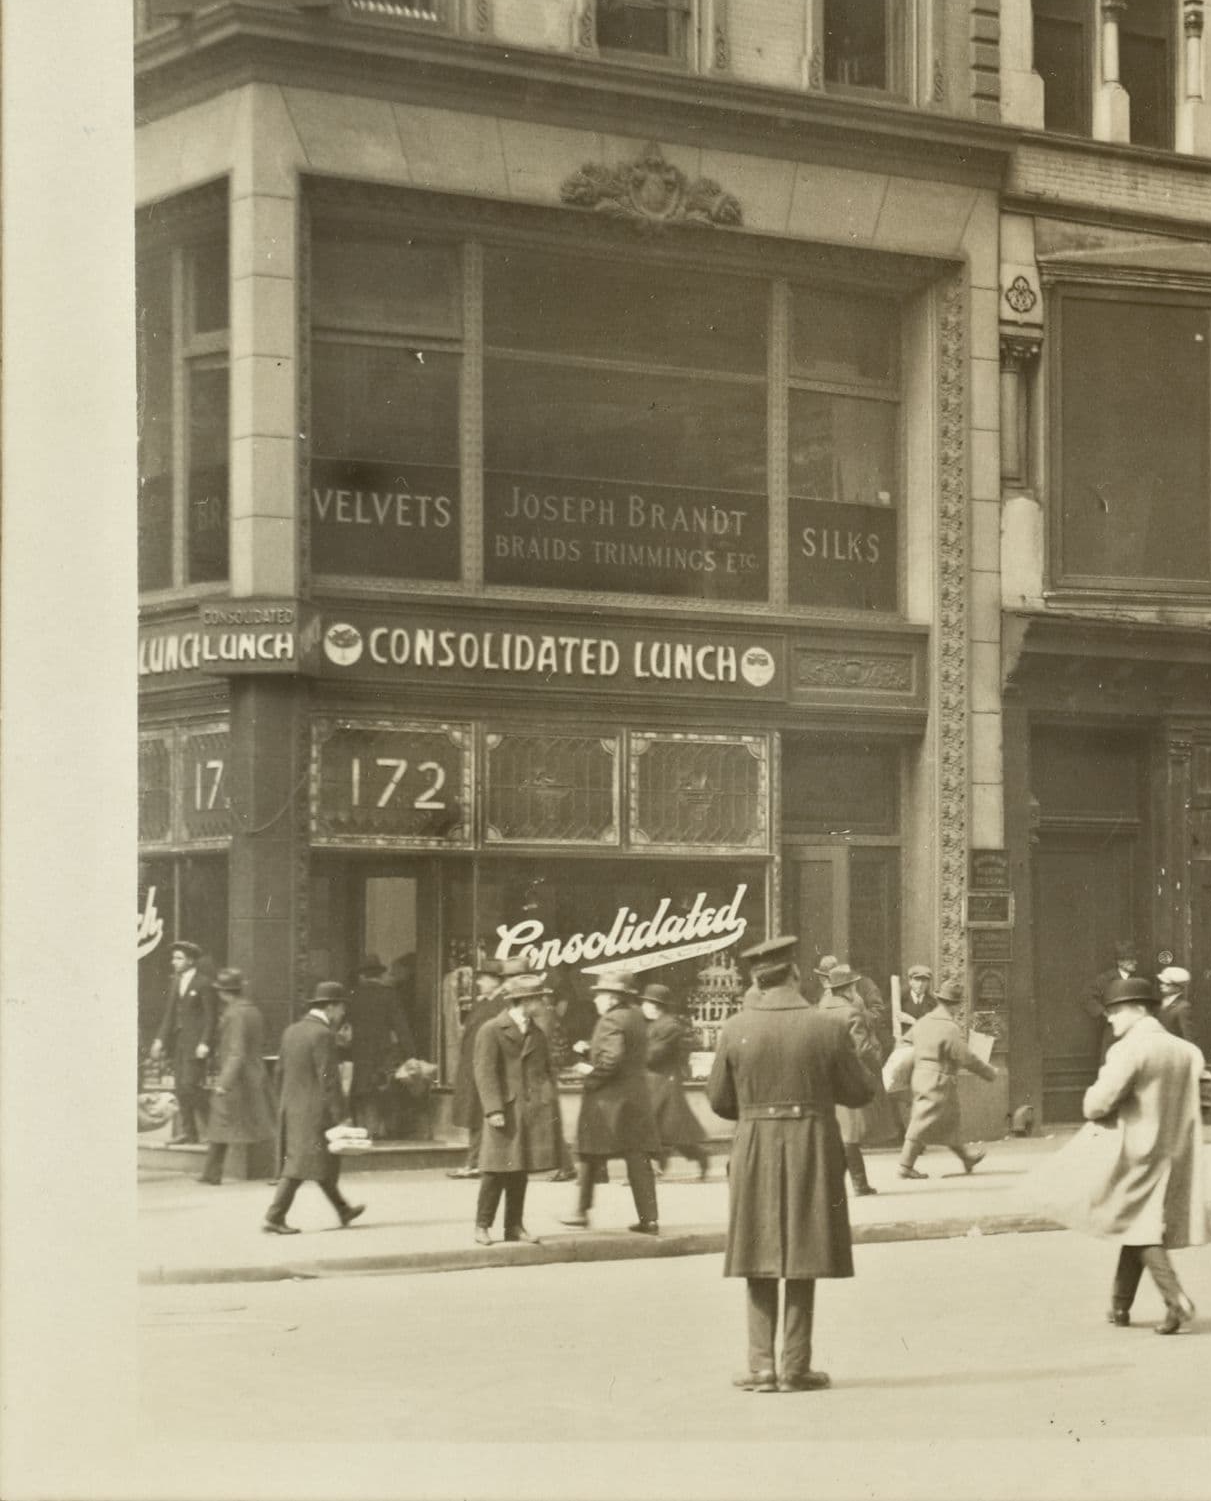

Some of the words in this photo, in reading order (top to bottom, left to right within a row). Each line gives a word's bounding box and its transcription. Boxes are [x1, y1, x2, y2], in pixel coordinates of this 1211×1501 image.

[311, 489, 452, 528] VELVETS
[503, 486, 616, 526] JOSEPH
[628, 496, 748, 537] BRANDT
[494, 534, 581, 563] BRAIDS
[594, 542, 716, 573] TRIMMINGS
[801, 528, 880, 564] SILKS
[203, 607, 294, 625] CONSOLIDATED
[203, 632, 294, 660] LUNCH
[369, 626, 620, 677] CONSOLIDATED
[633, 638, 738, 683] LUNCH
[195, 760, 233, 812] 17
[351, 758, 447, 810] 172
[495, 884, 748, 970] Consolidated
